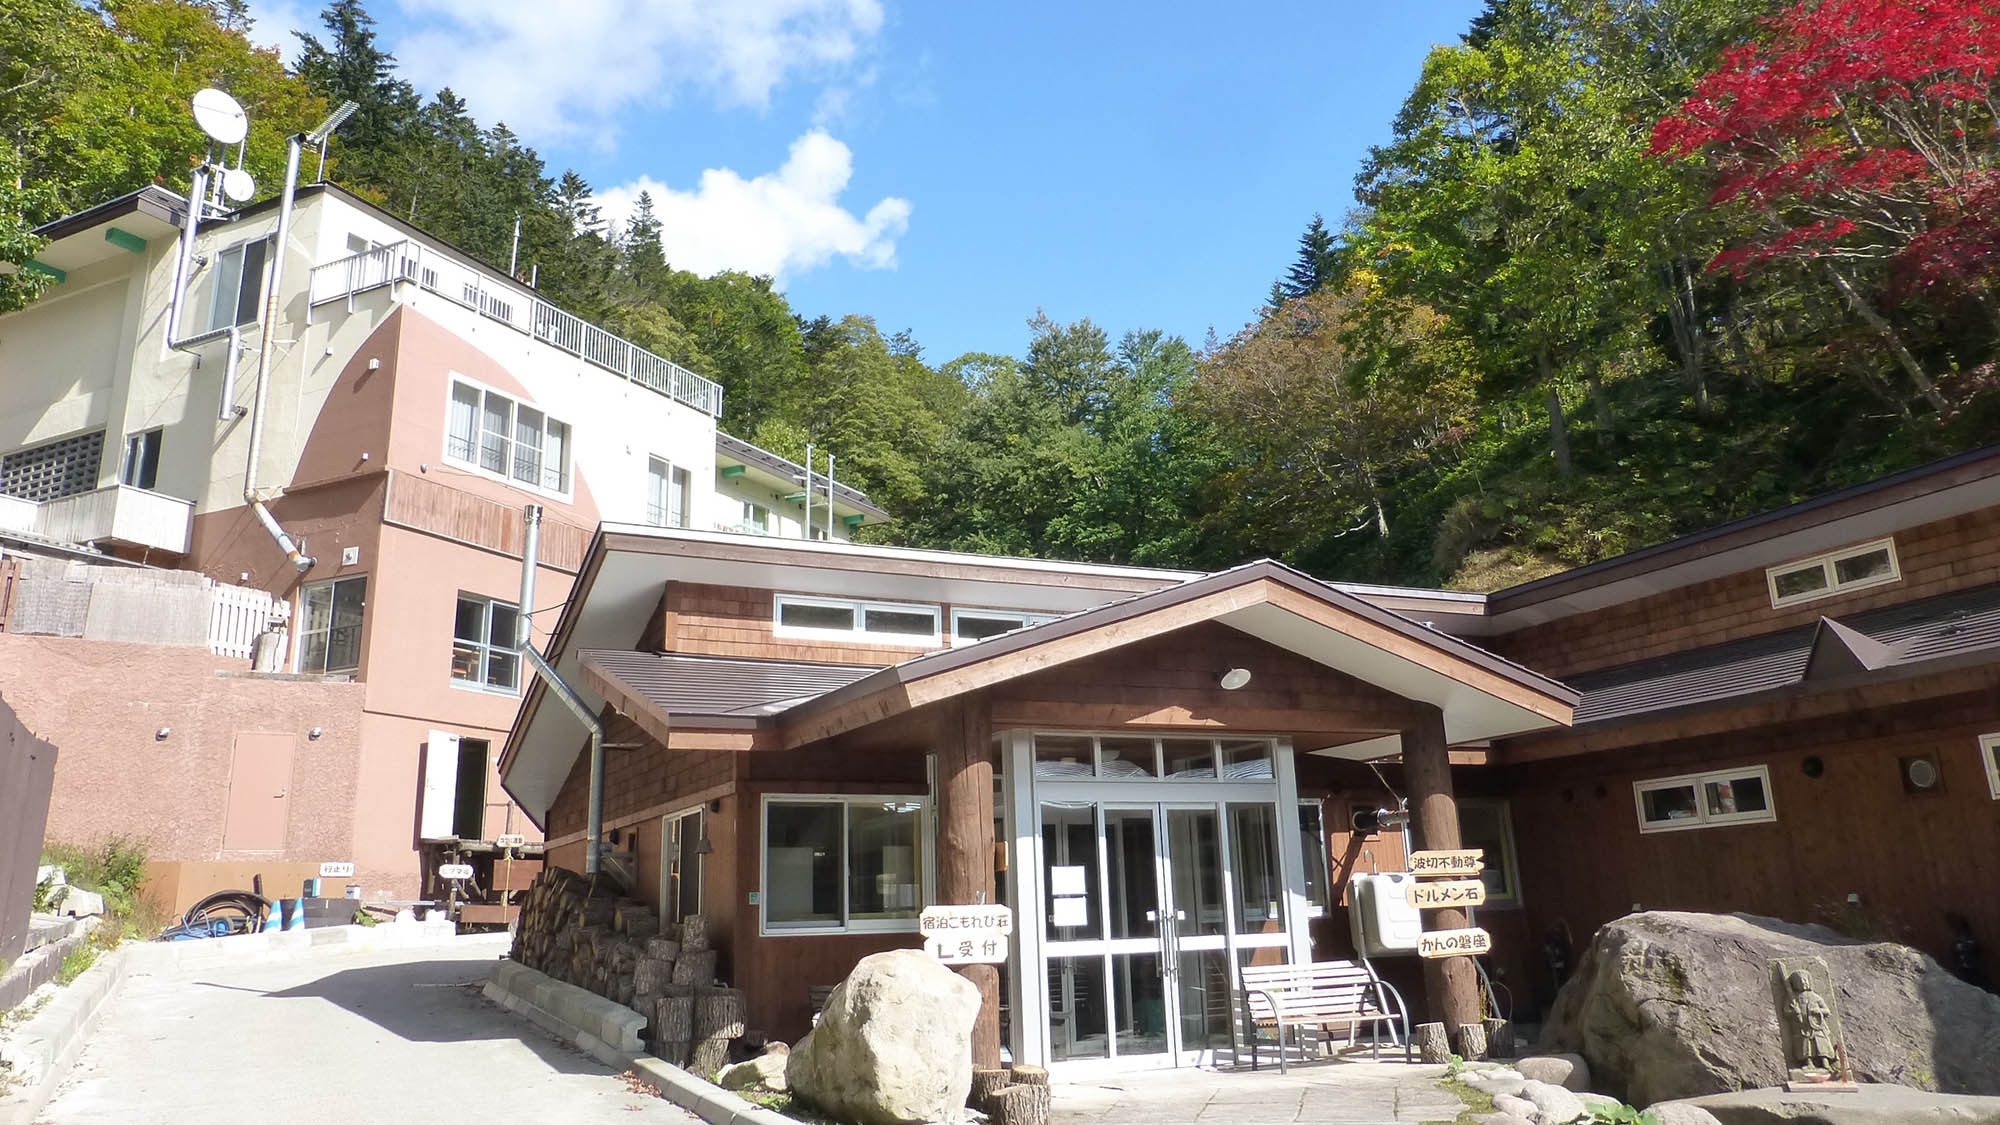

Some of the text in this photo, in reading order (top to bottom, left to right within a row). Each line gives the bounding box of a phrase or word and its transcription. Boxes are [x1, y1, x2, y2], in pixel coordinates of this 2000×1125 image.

[1413, 856, 1476, 869] 波切不動尊
[1414, 887, 1478, 903] ドルメン石
[1421, 934, 1487, 951] かんの磐座
